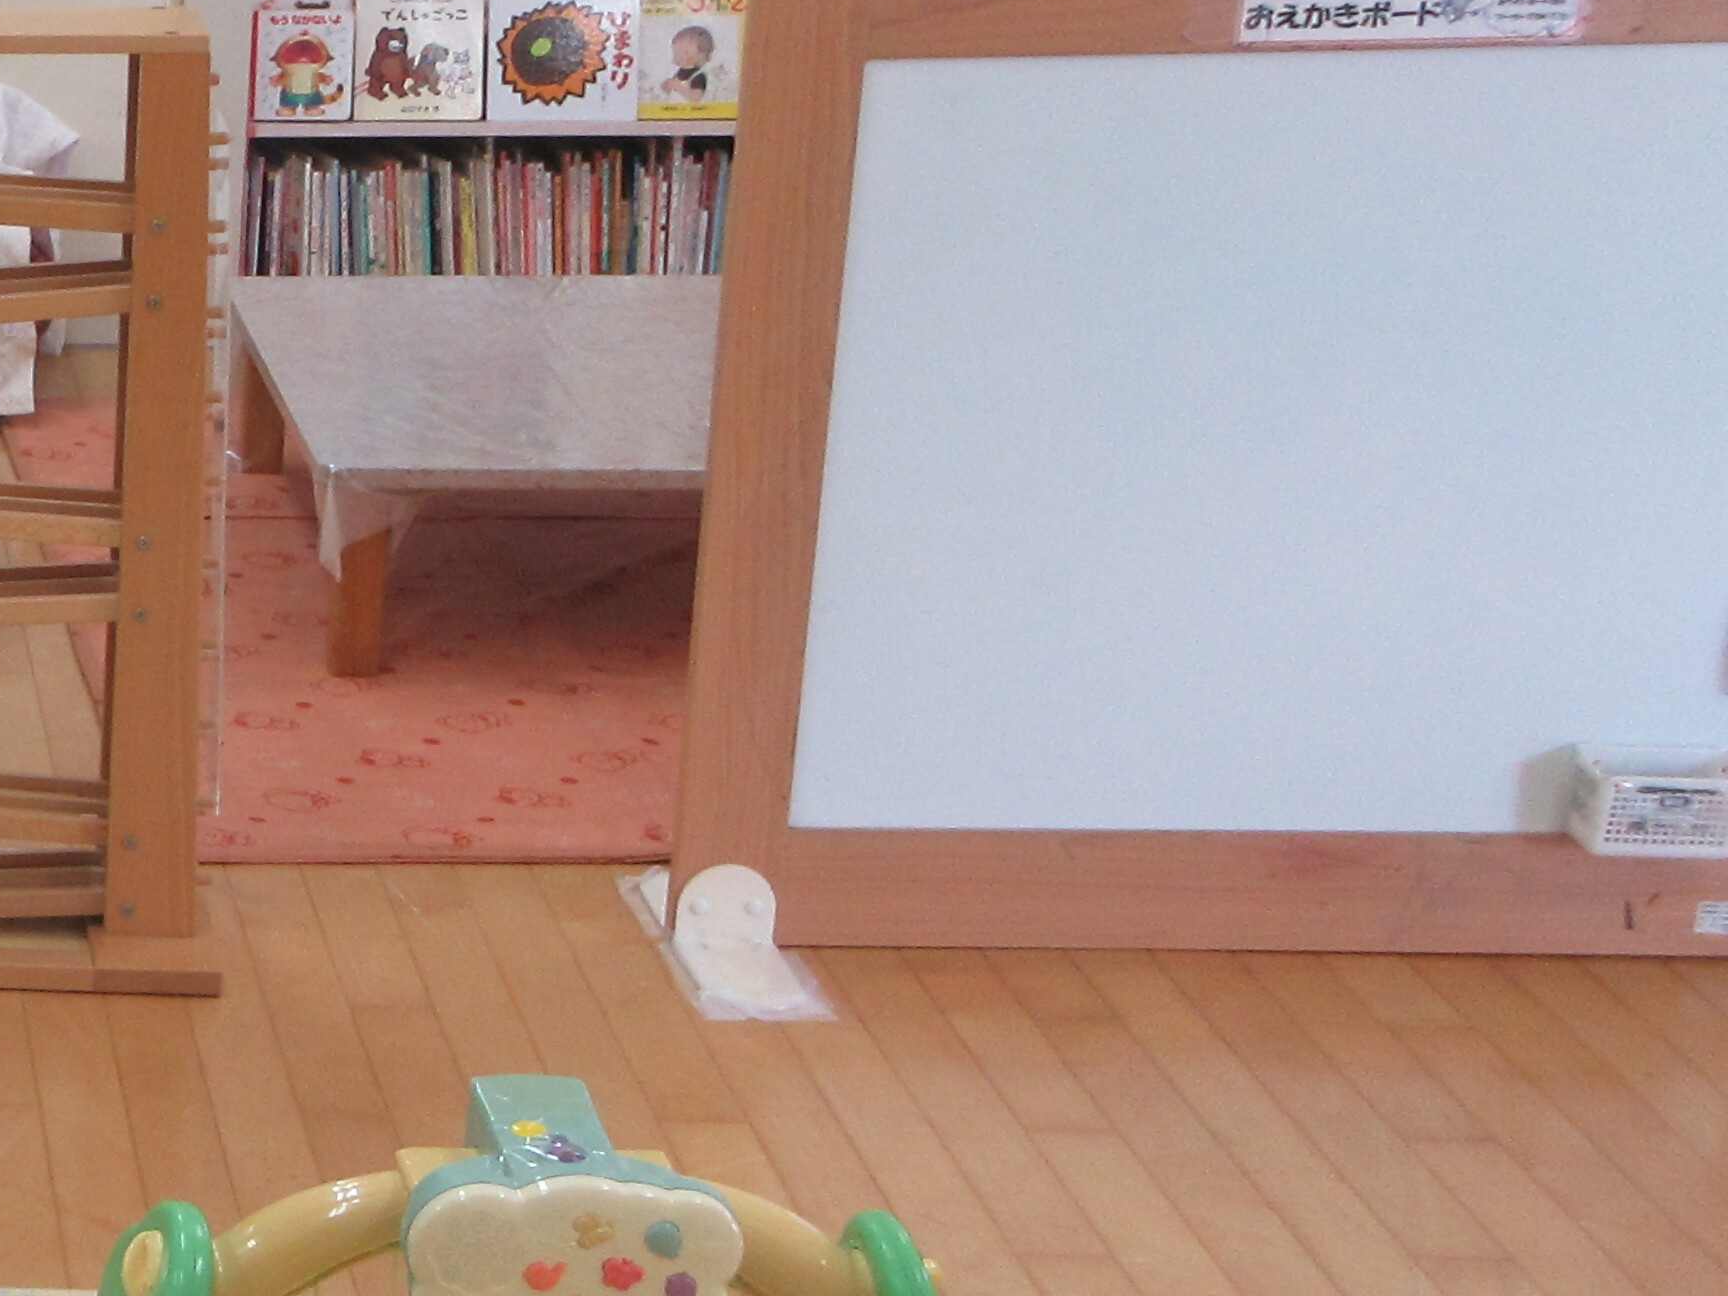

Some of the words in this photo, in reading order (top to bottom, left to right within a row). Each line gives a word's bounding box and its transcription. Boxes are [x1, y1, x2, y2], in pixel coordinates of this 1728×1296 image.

[381, 7, 469, 22] でんしゃごっこ
[1244, 0, 1442, 29] おえかきボード
[606, 11, 634, 90] ひまわり
